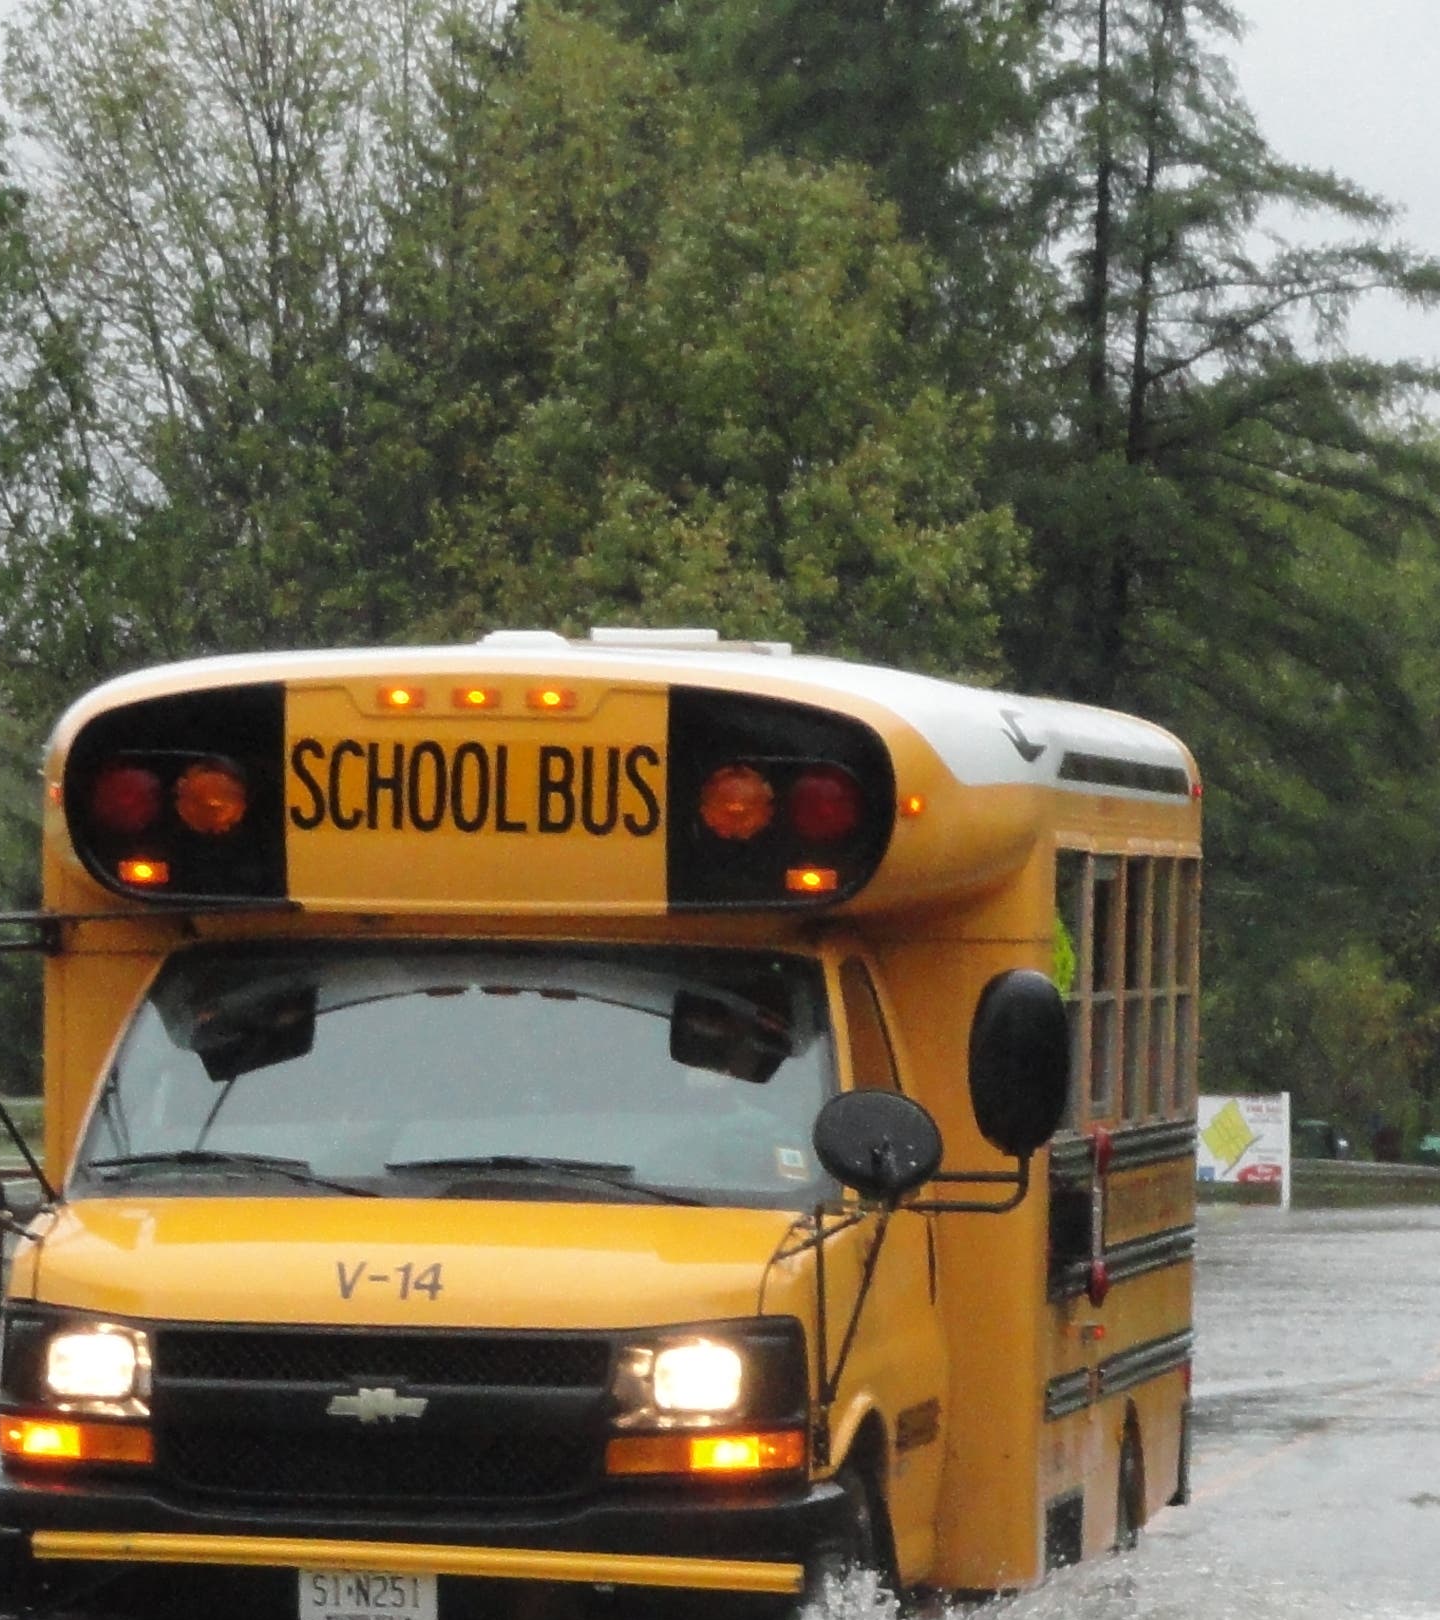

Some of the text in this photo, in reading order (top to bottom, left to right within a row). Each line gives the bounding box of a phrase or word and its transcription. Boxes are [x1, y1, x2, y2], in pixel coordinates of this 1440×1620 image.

[290, 738, 660, 837] SCHOOL BUS
[337, 1262, 443, 1300] V-14
